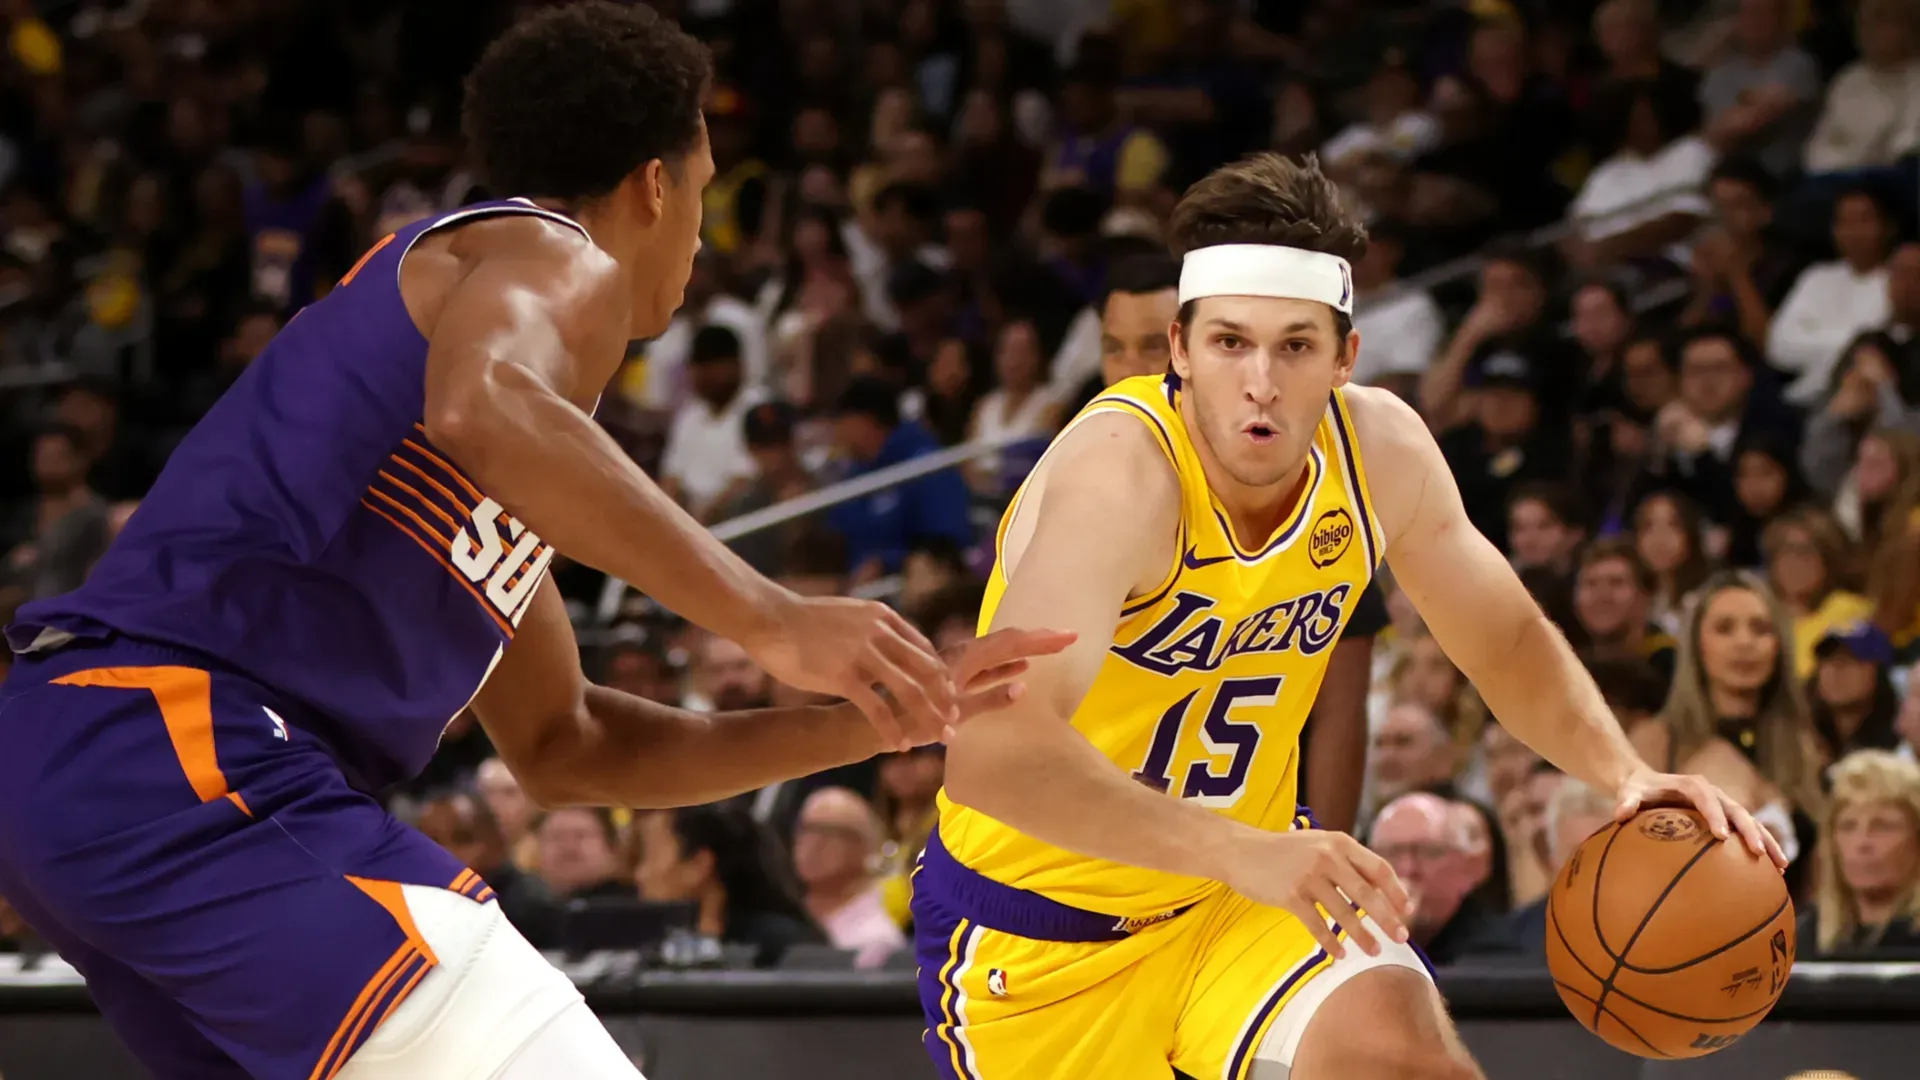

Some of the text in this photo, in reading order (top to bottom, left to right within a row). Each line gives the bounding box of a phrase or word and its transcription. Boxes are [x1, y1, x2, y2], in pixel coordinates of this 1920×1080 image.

[450, 496, 555, 629] SU
[1313, 524, 1350, 550] bibigo
[1108, 582, 1352, 679] LAKERS
[1131, 674, 1287, 808] 15
